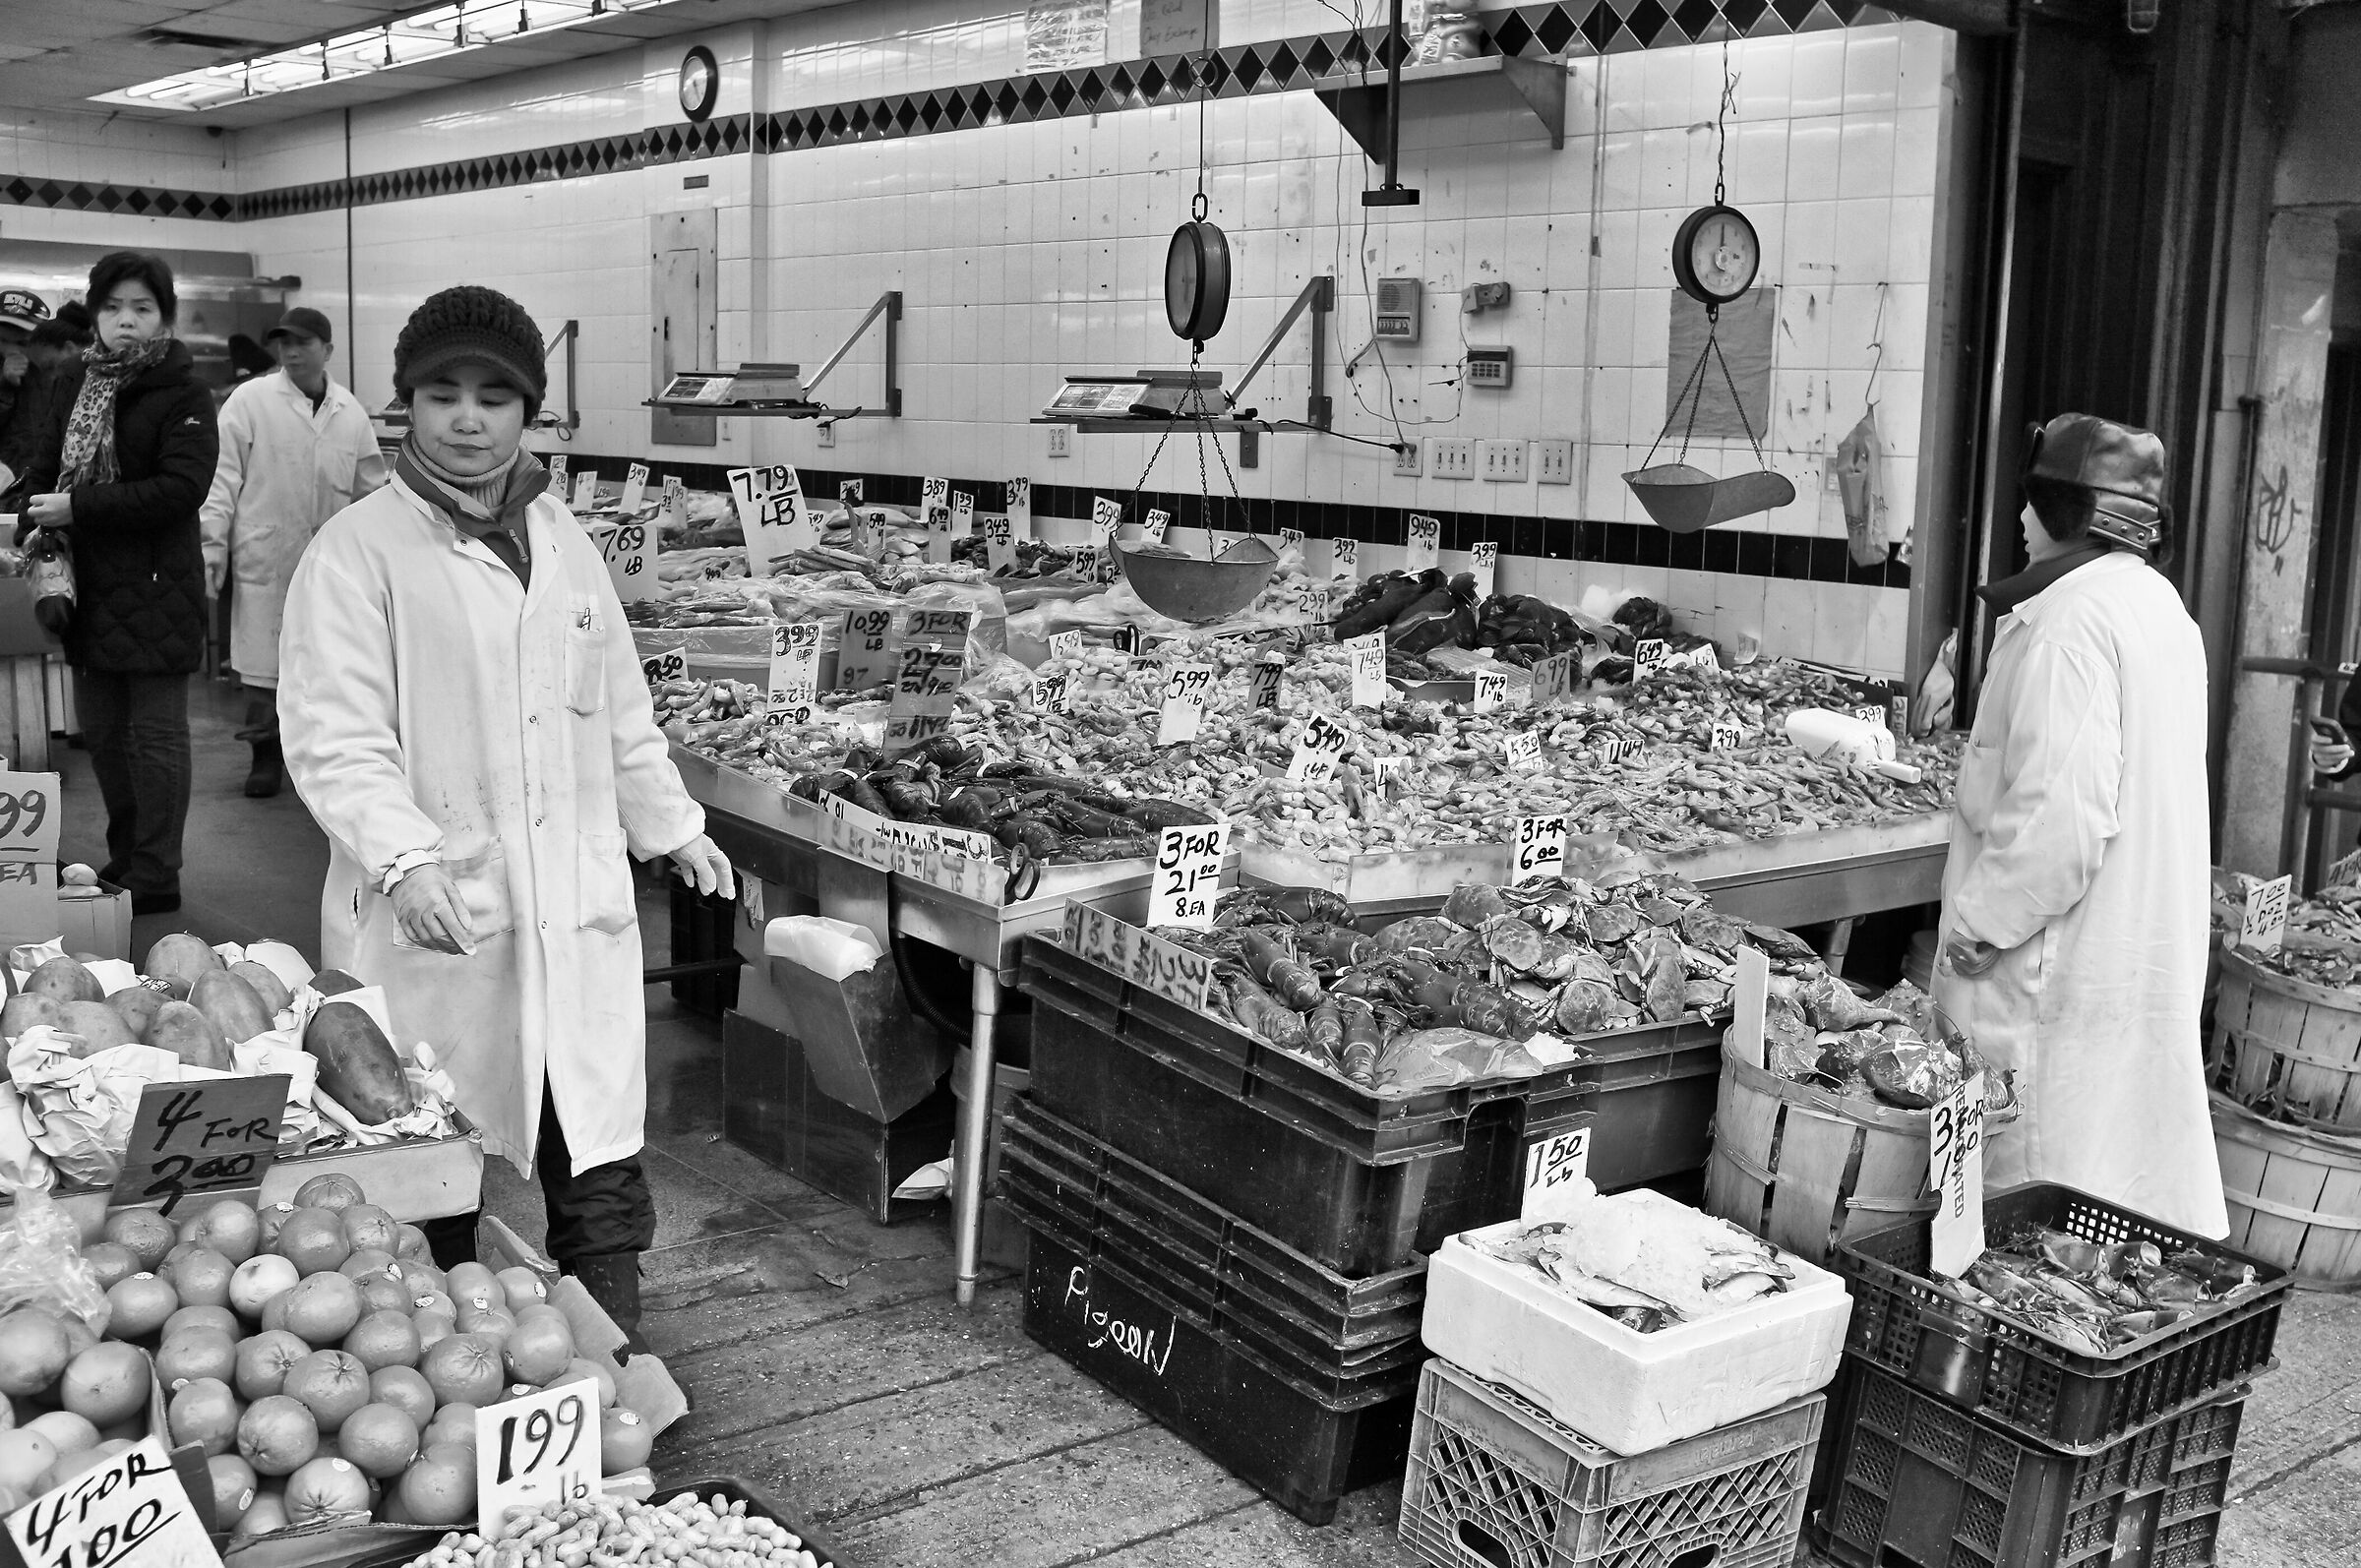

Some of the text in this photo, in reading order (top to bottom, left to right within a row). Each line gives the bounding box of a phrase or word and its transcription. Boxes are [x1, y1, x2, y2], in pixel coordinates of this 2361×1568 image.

[1159, 830, 1221, 870] 3 FOR
[1520, 818, 1535, 843] 3
[152, 1089, 279, 1152] 4 FOR
[1933, 1107, 1954, 1158] 3
[26, 1451, 173, 1558] 4 FOR
